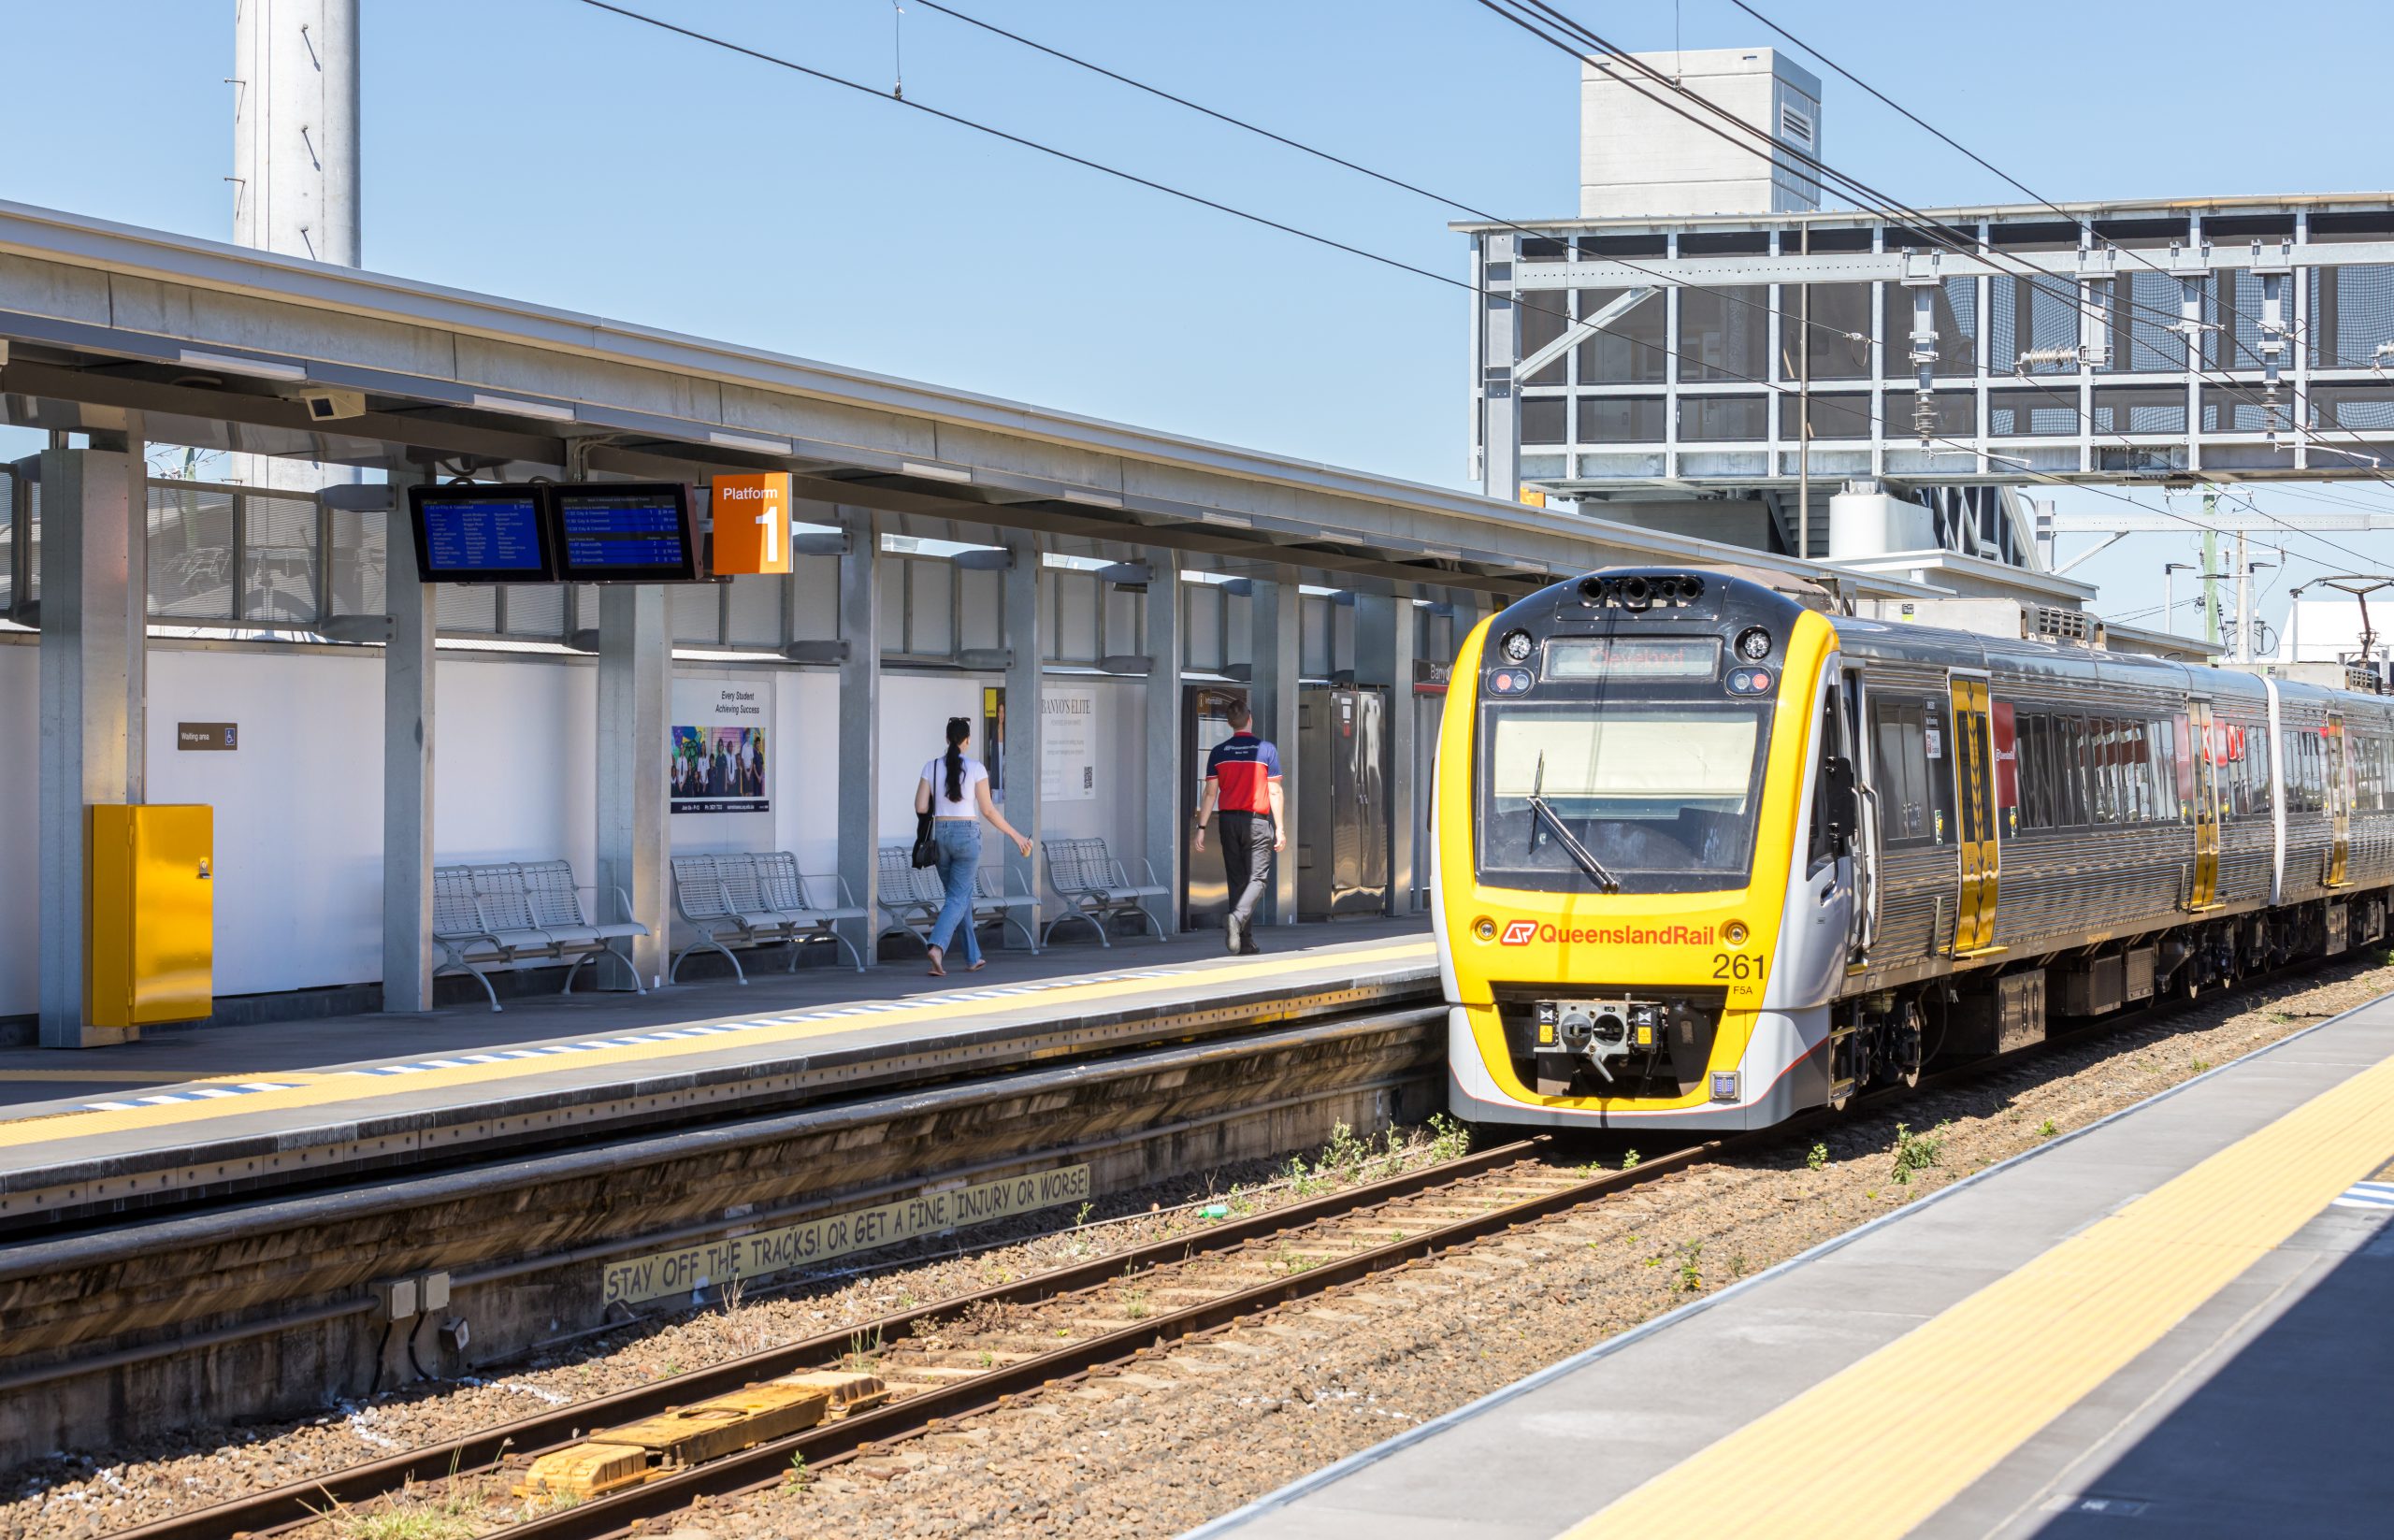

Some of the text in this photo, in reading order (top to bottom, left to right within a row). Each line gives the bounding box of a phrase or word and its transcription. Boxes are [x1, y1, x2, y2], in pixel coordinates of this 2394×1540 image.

[724, 486, 778, 500] Platform
[756, 506, 778, 563] 1
[1589, 646, 1684, 669] Cleveland
[721, 690, 755, 702] Every Student
[715, 704, 760, 715] Achieving Success
[1042, 698, 1091, 714] BANYO'S ELITE
[180, 732, 199, 742] Waiting
[1540, 924, 1714, 945] QueenslandRail
[1712, 954, 1765, 980] 261
[1733, 986, 1753, 996] F5A
[605, 1163, 1089, 1301] STAY OFF THE TRACKS! OR GET A FINE, INJURY OR WORSE!
